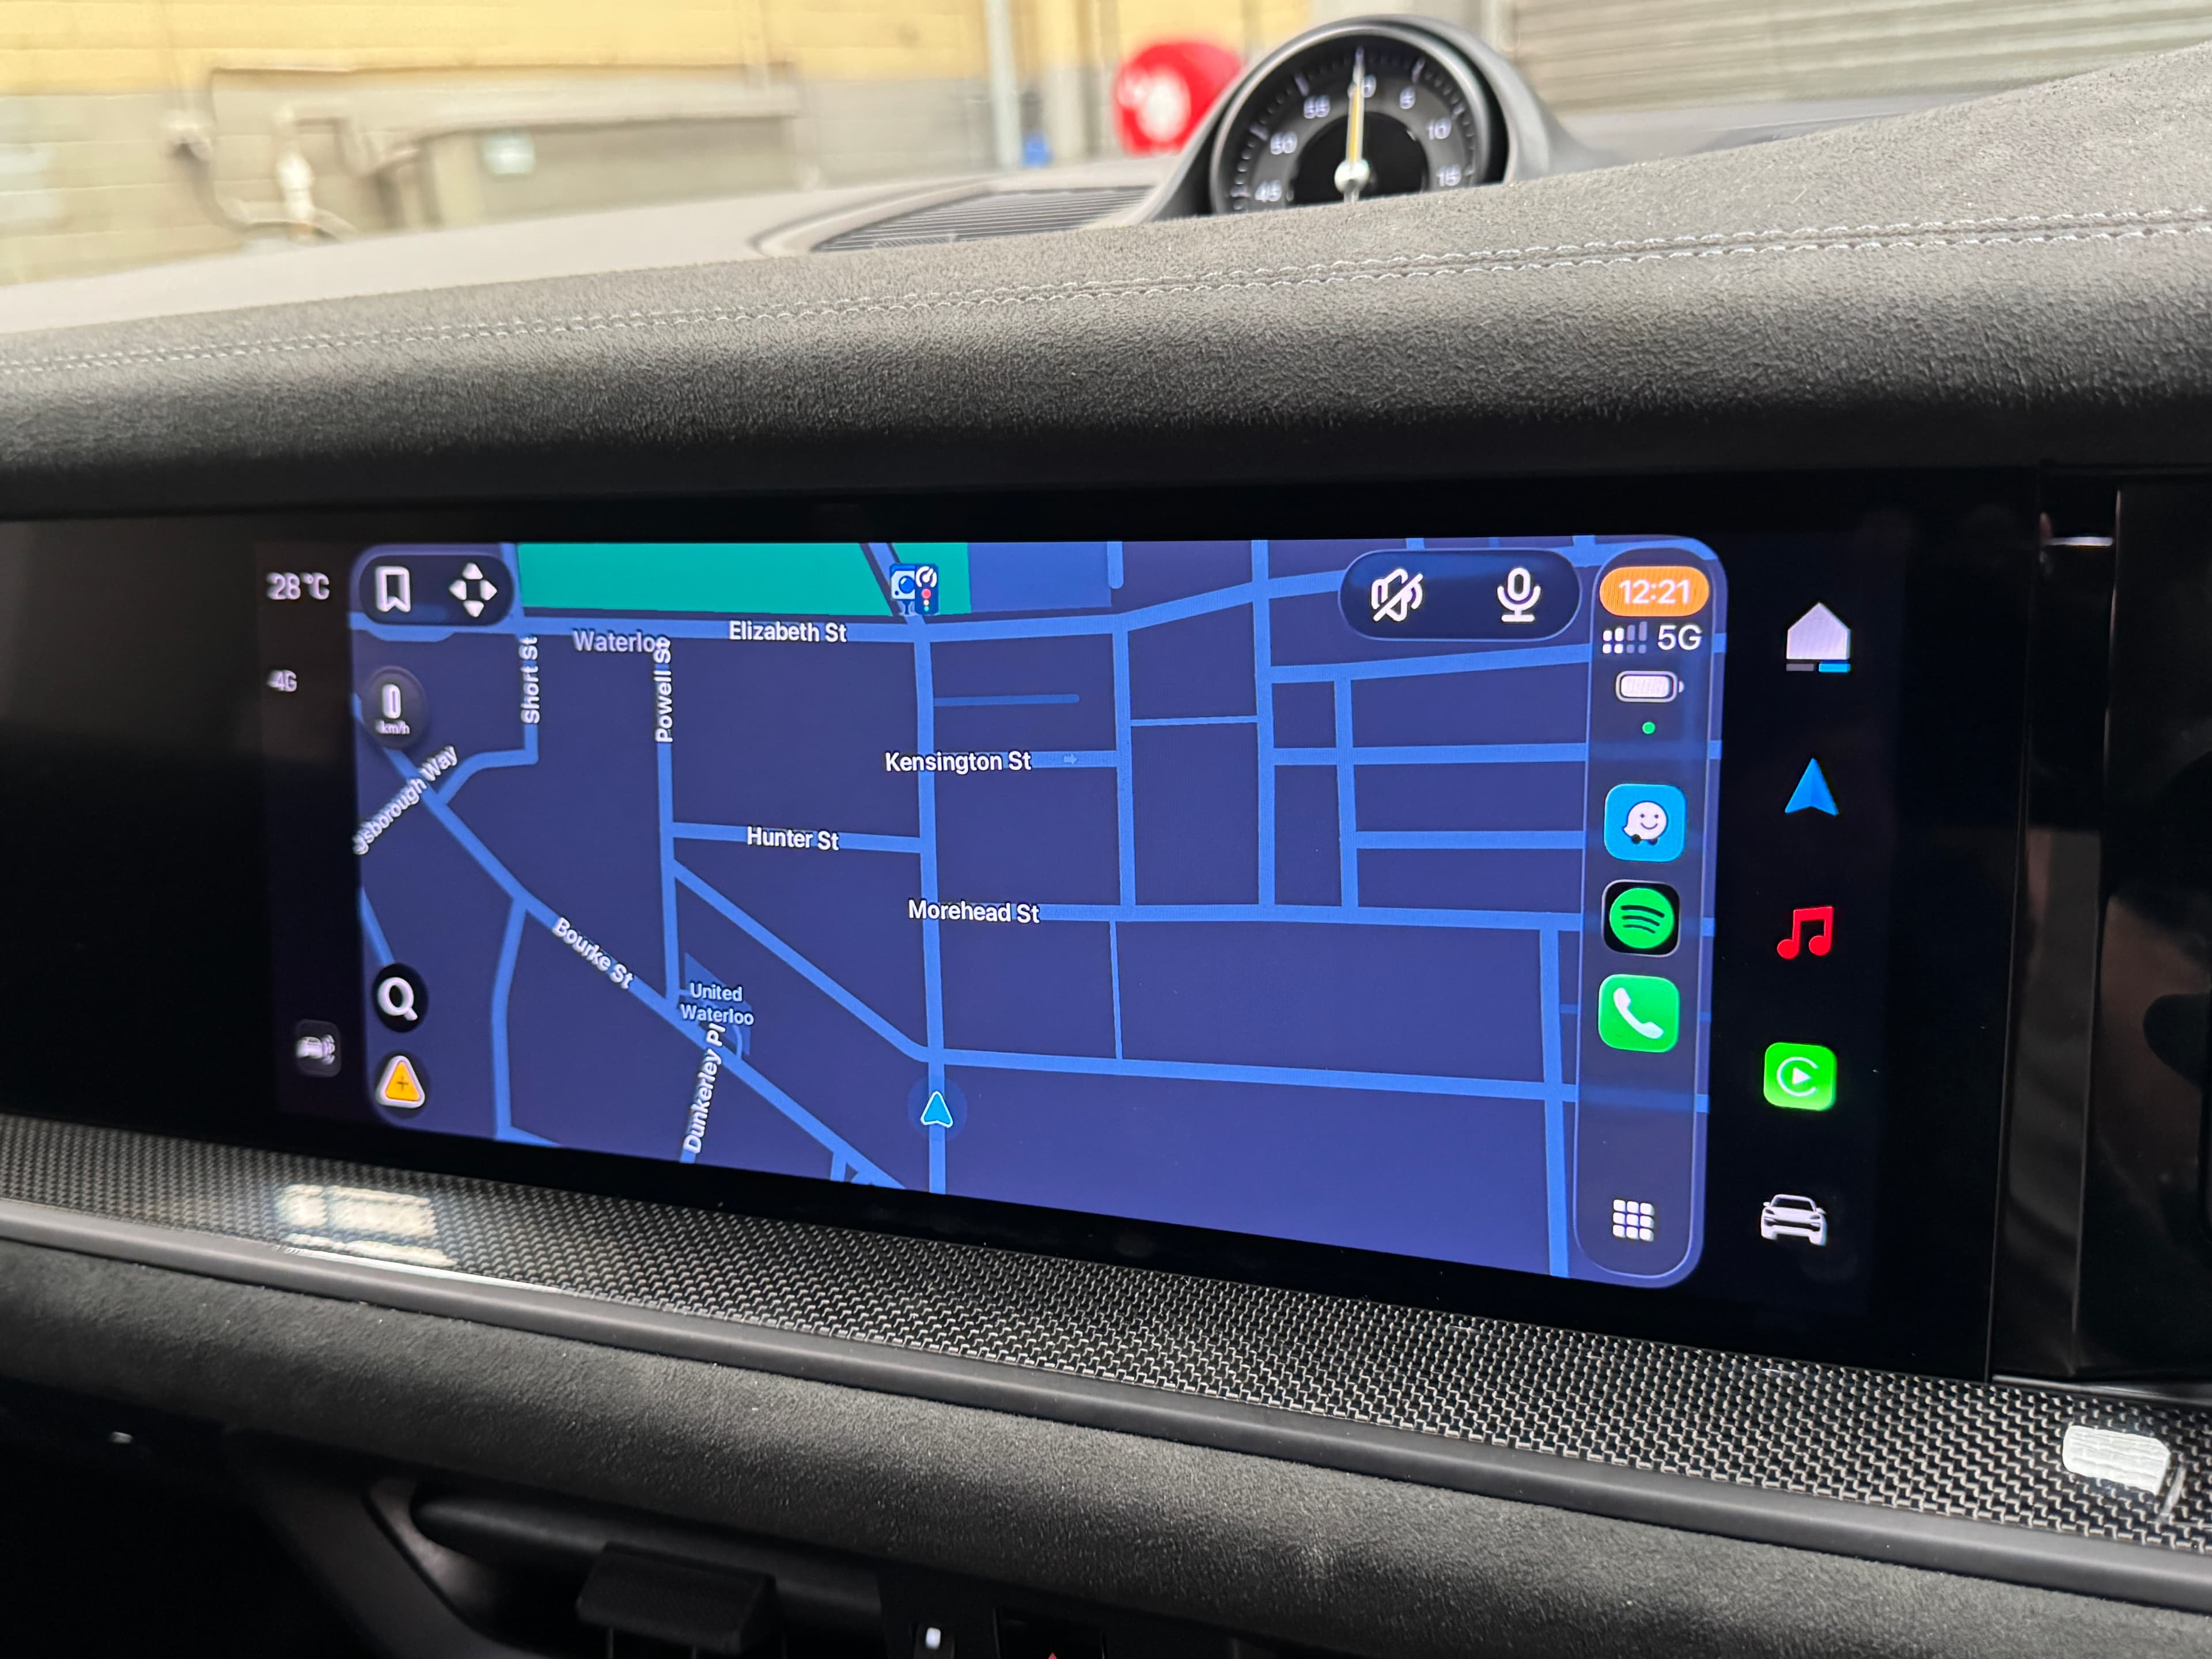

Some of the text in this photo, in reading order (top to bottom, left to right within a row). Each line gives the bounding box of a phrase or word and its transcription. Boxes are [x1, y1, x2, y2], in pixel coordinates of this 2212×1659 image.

[1347, 74, 1377, 99] 0
[1400, 86, 1415, 109] 5
[1304, 94, 1330, 119] 55
[1427, 116, 1452, 139] 10
[1270, 131, 1298, 155] 50
[1437, 164, 1461, 187] 15
[1255, 179, 1282, 202] 45
[1619, 579, 1690, 604] 12:21
[729, 620, 847, 643] Elizabeth St
[1657, 624, 1702, 651] 5G
[267, 669, 297, 692] 4G
[519, 636, 540, 724] Short St
[653, 639, 673, 743] Powell St
[382, 684, 402, 719] 0
[375, 720, 410, 734] km/h
[420, 745, 457, 781] Way
[885, 751, 1032, 774] Kensington St
[747, 826, 839, 851] Hunter St
[908, 900, 1040, 924] Morehead St
[551, 917, 634, 989] Bourke St
[690, 983, 743, 1002] United
[680, 1003, 755, 1025] Waterloo
[683, 1023, 725, 1154] Dunkerley Pl
